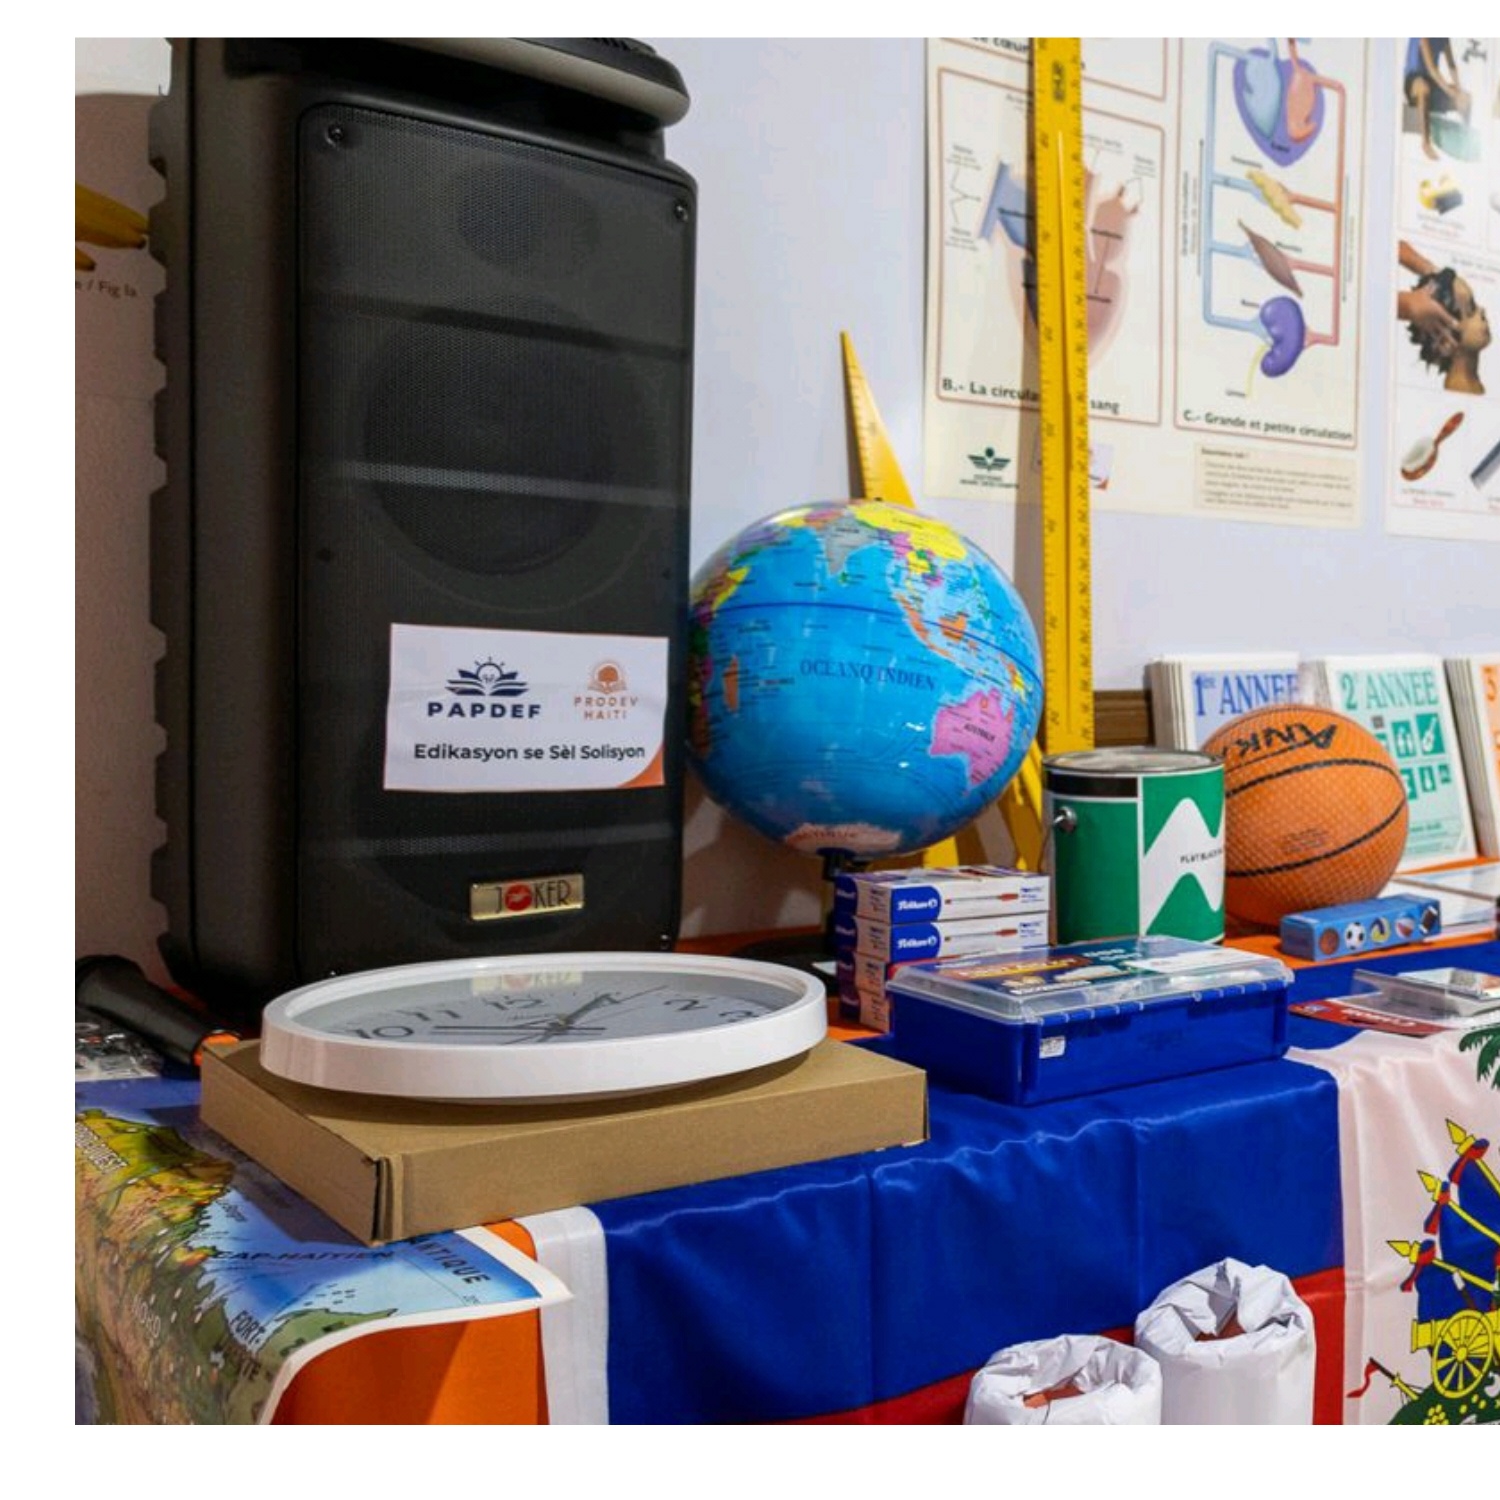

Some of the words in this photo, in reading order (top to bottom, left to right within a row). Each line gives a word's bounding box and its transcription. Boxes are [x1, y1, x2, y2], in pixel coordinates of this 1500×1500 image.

[970, 381, 988, 396] La
[1090, 400, 1120, 415] sang
[1205, 412, 1246, 428] Grande
[1250, 419, 1261, 429] et
[1264, 422, 1296, 434] petite
[1299, 426, 1353, 441] circulation
[1365, 670, 1439, 710] ANNEE
[427, 702, 542, 719] PAPDEF
[573, 696, 639, 709] PRODEV
[583, 709, 628, 720] HAITI
[414, 743, 518, 763] Edikasyon
[523, 747, 544, 760] se
[549, 744, 576, 760] Sèl
[581, 744, 646, 763] Solisyon
